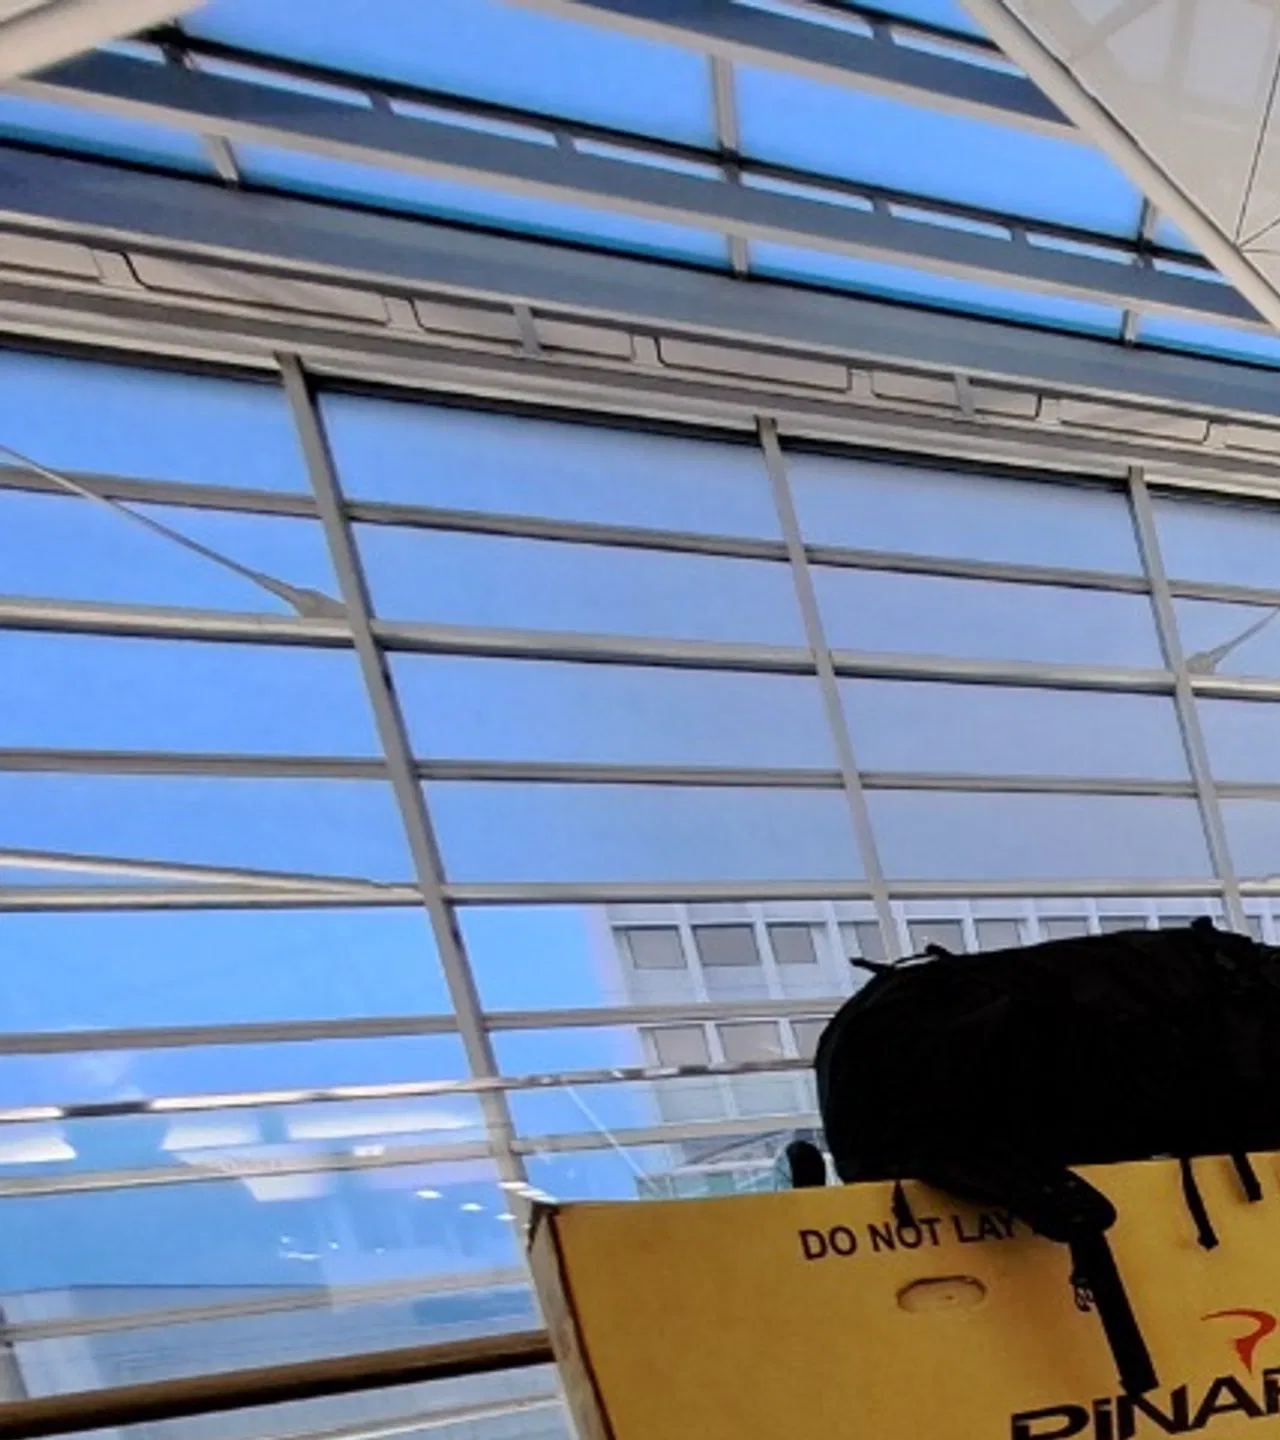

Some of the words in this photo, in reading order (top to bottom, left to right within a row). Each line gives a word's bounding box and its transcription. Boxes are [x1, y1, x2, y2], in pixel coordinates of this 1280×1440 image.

[798, 1225, 858, 1261] DO
[866, 1216, 942, 1252] NOT
[952, 1211, 1015, 1244] LAY
